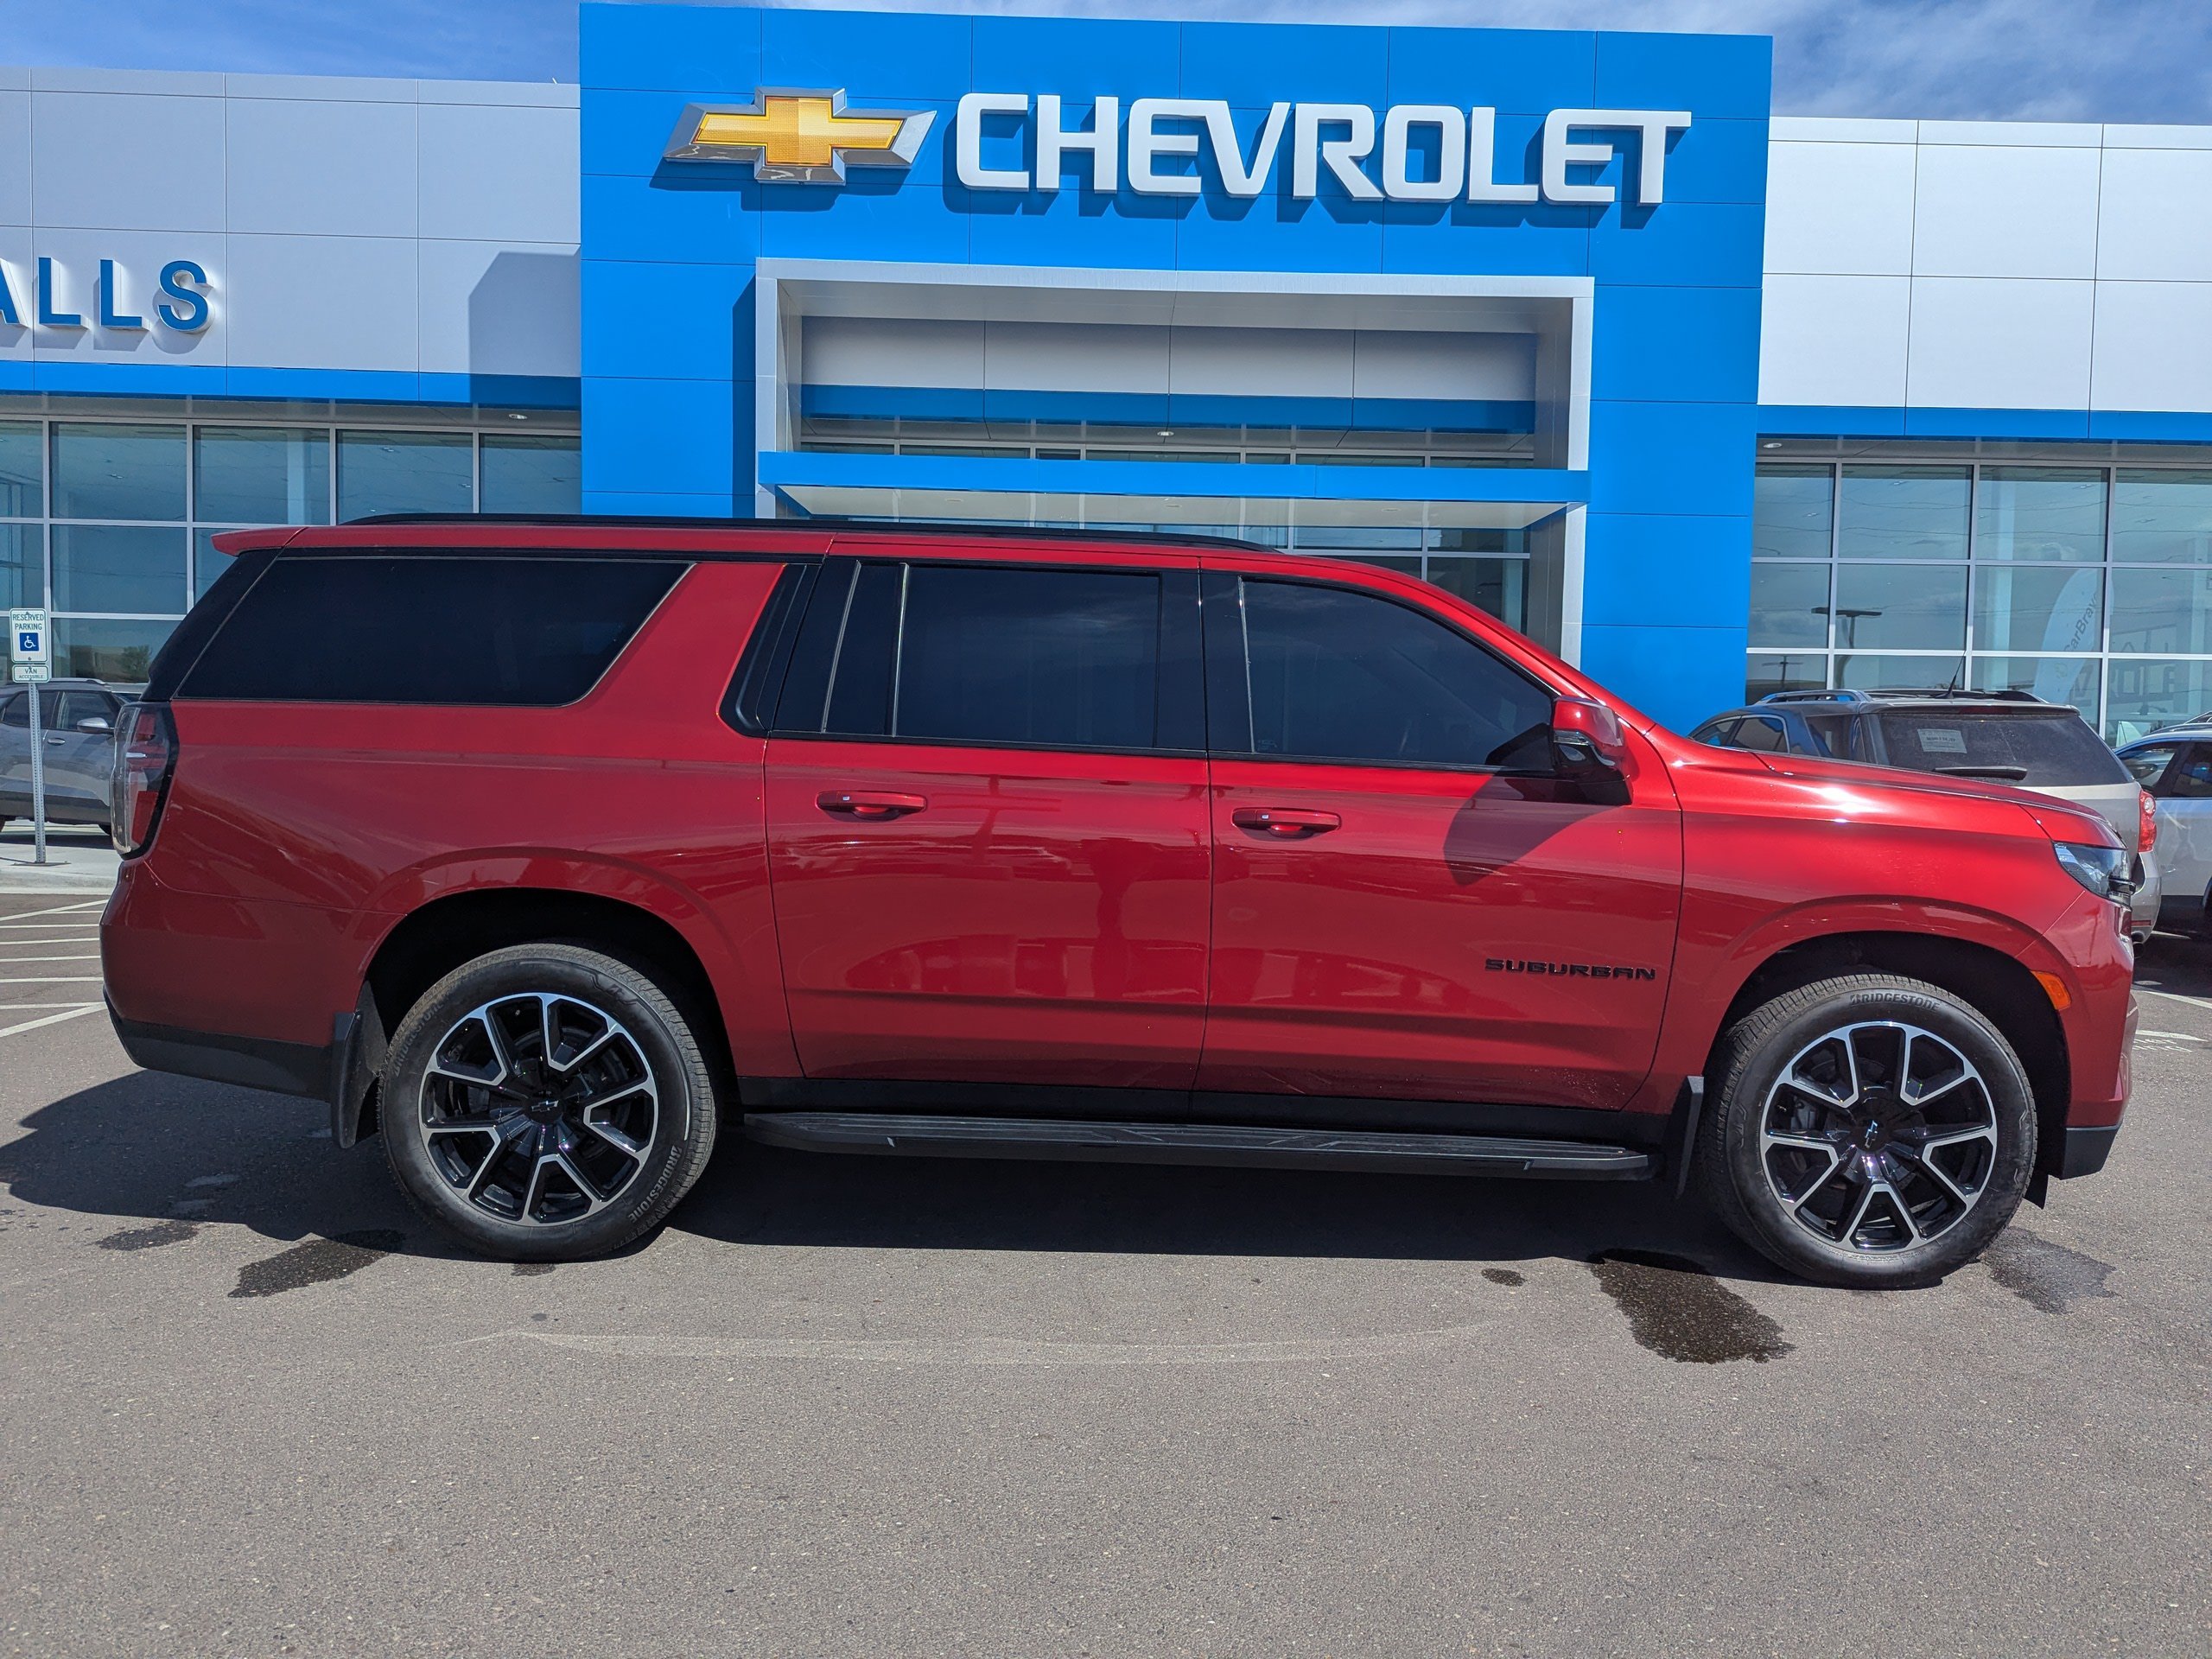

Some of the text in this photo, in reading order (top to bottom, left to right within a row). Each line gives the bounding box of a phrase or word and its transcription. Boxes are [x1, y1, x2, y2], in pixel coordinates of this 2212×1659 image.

[957, 92, 1693, 205] CHEVROLET
[1484, 958, 1656, 981] SUBURBAN
[1850, 992, 1940, 1012] BRIDGESTONE
[628, 1145, 683, 1224] BRIDGESTONE
